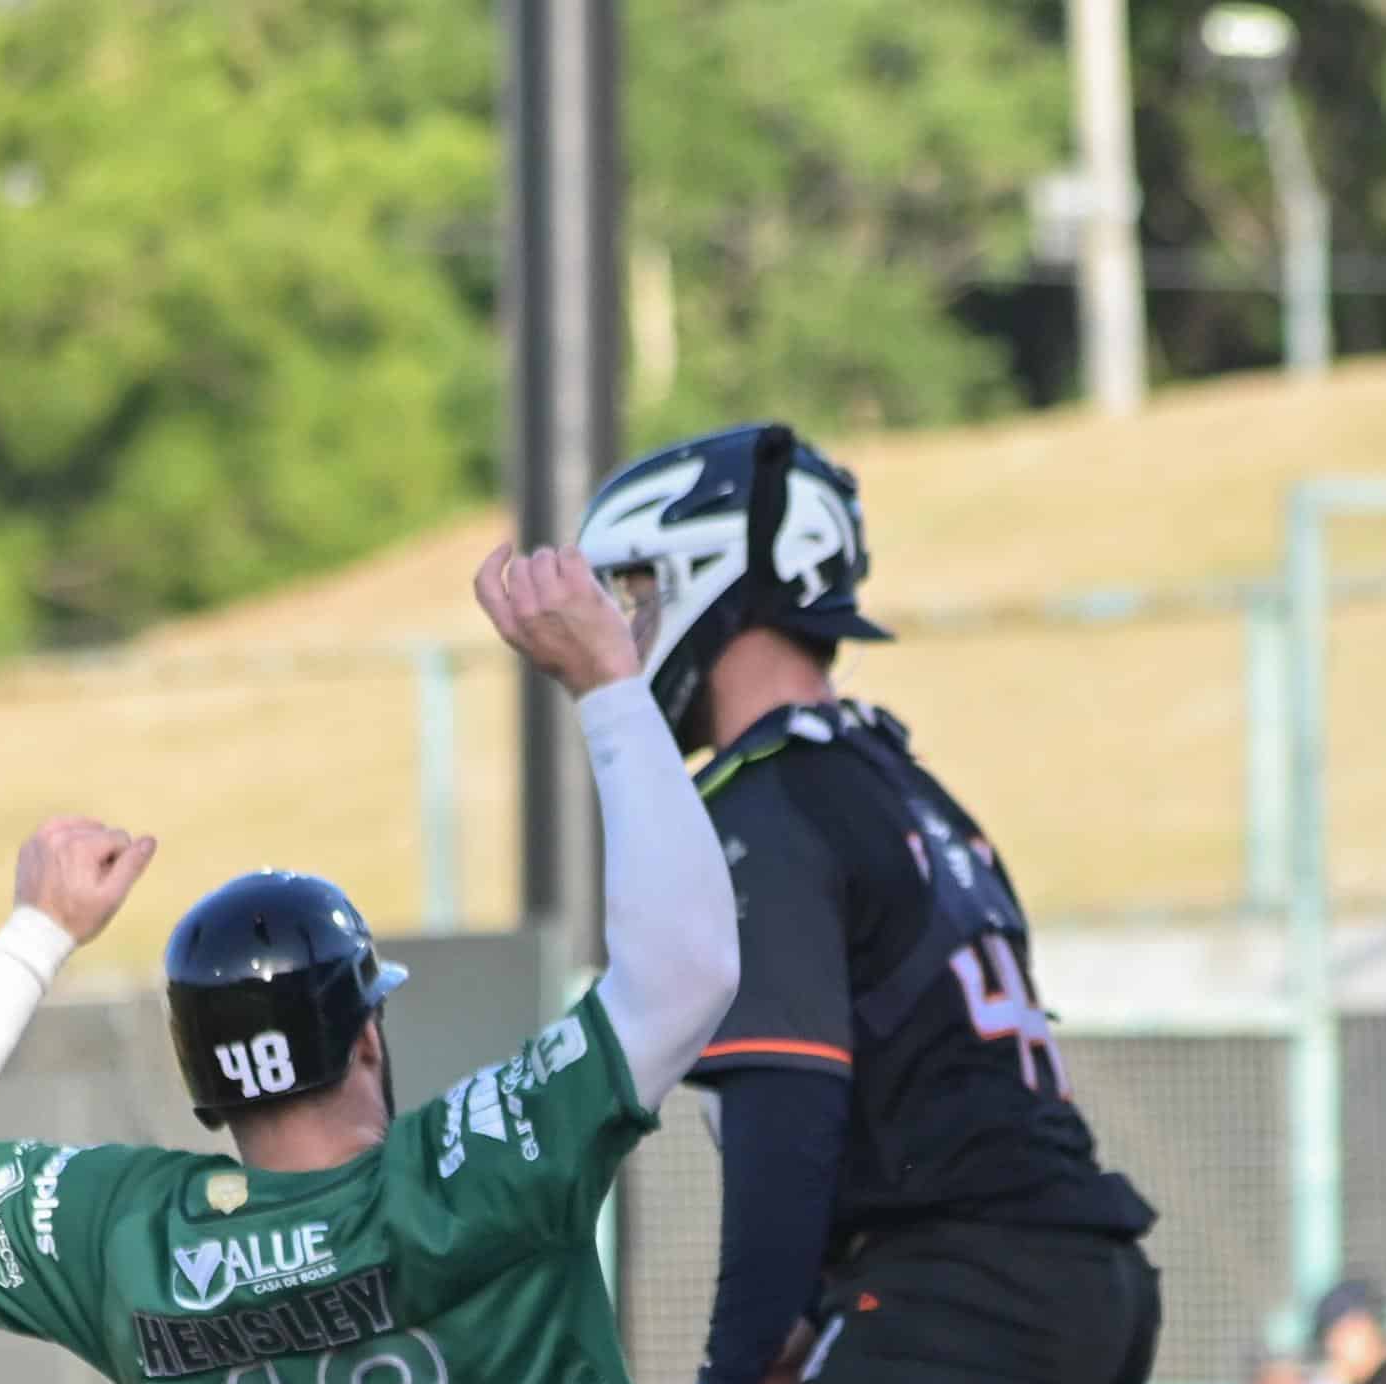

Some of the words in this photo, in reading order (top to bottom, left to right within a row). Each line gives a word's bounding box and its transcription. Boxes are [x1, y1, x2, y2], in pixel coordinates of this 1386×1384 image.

[214, 1031, 296, 1099] 48
[173, 1222, 334, 1302] VALUE
[253, 1280, 283, 1296] CASA
[284, 1276, 301, 1290] DE
[300, 1264, 338, 1283] BOLSA
[132, 1268, 394, 1378] HENSLEY
